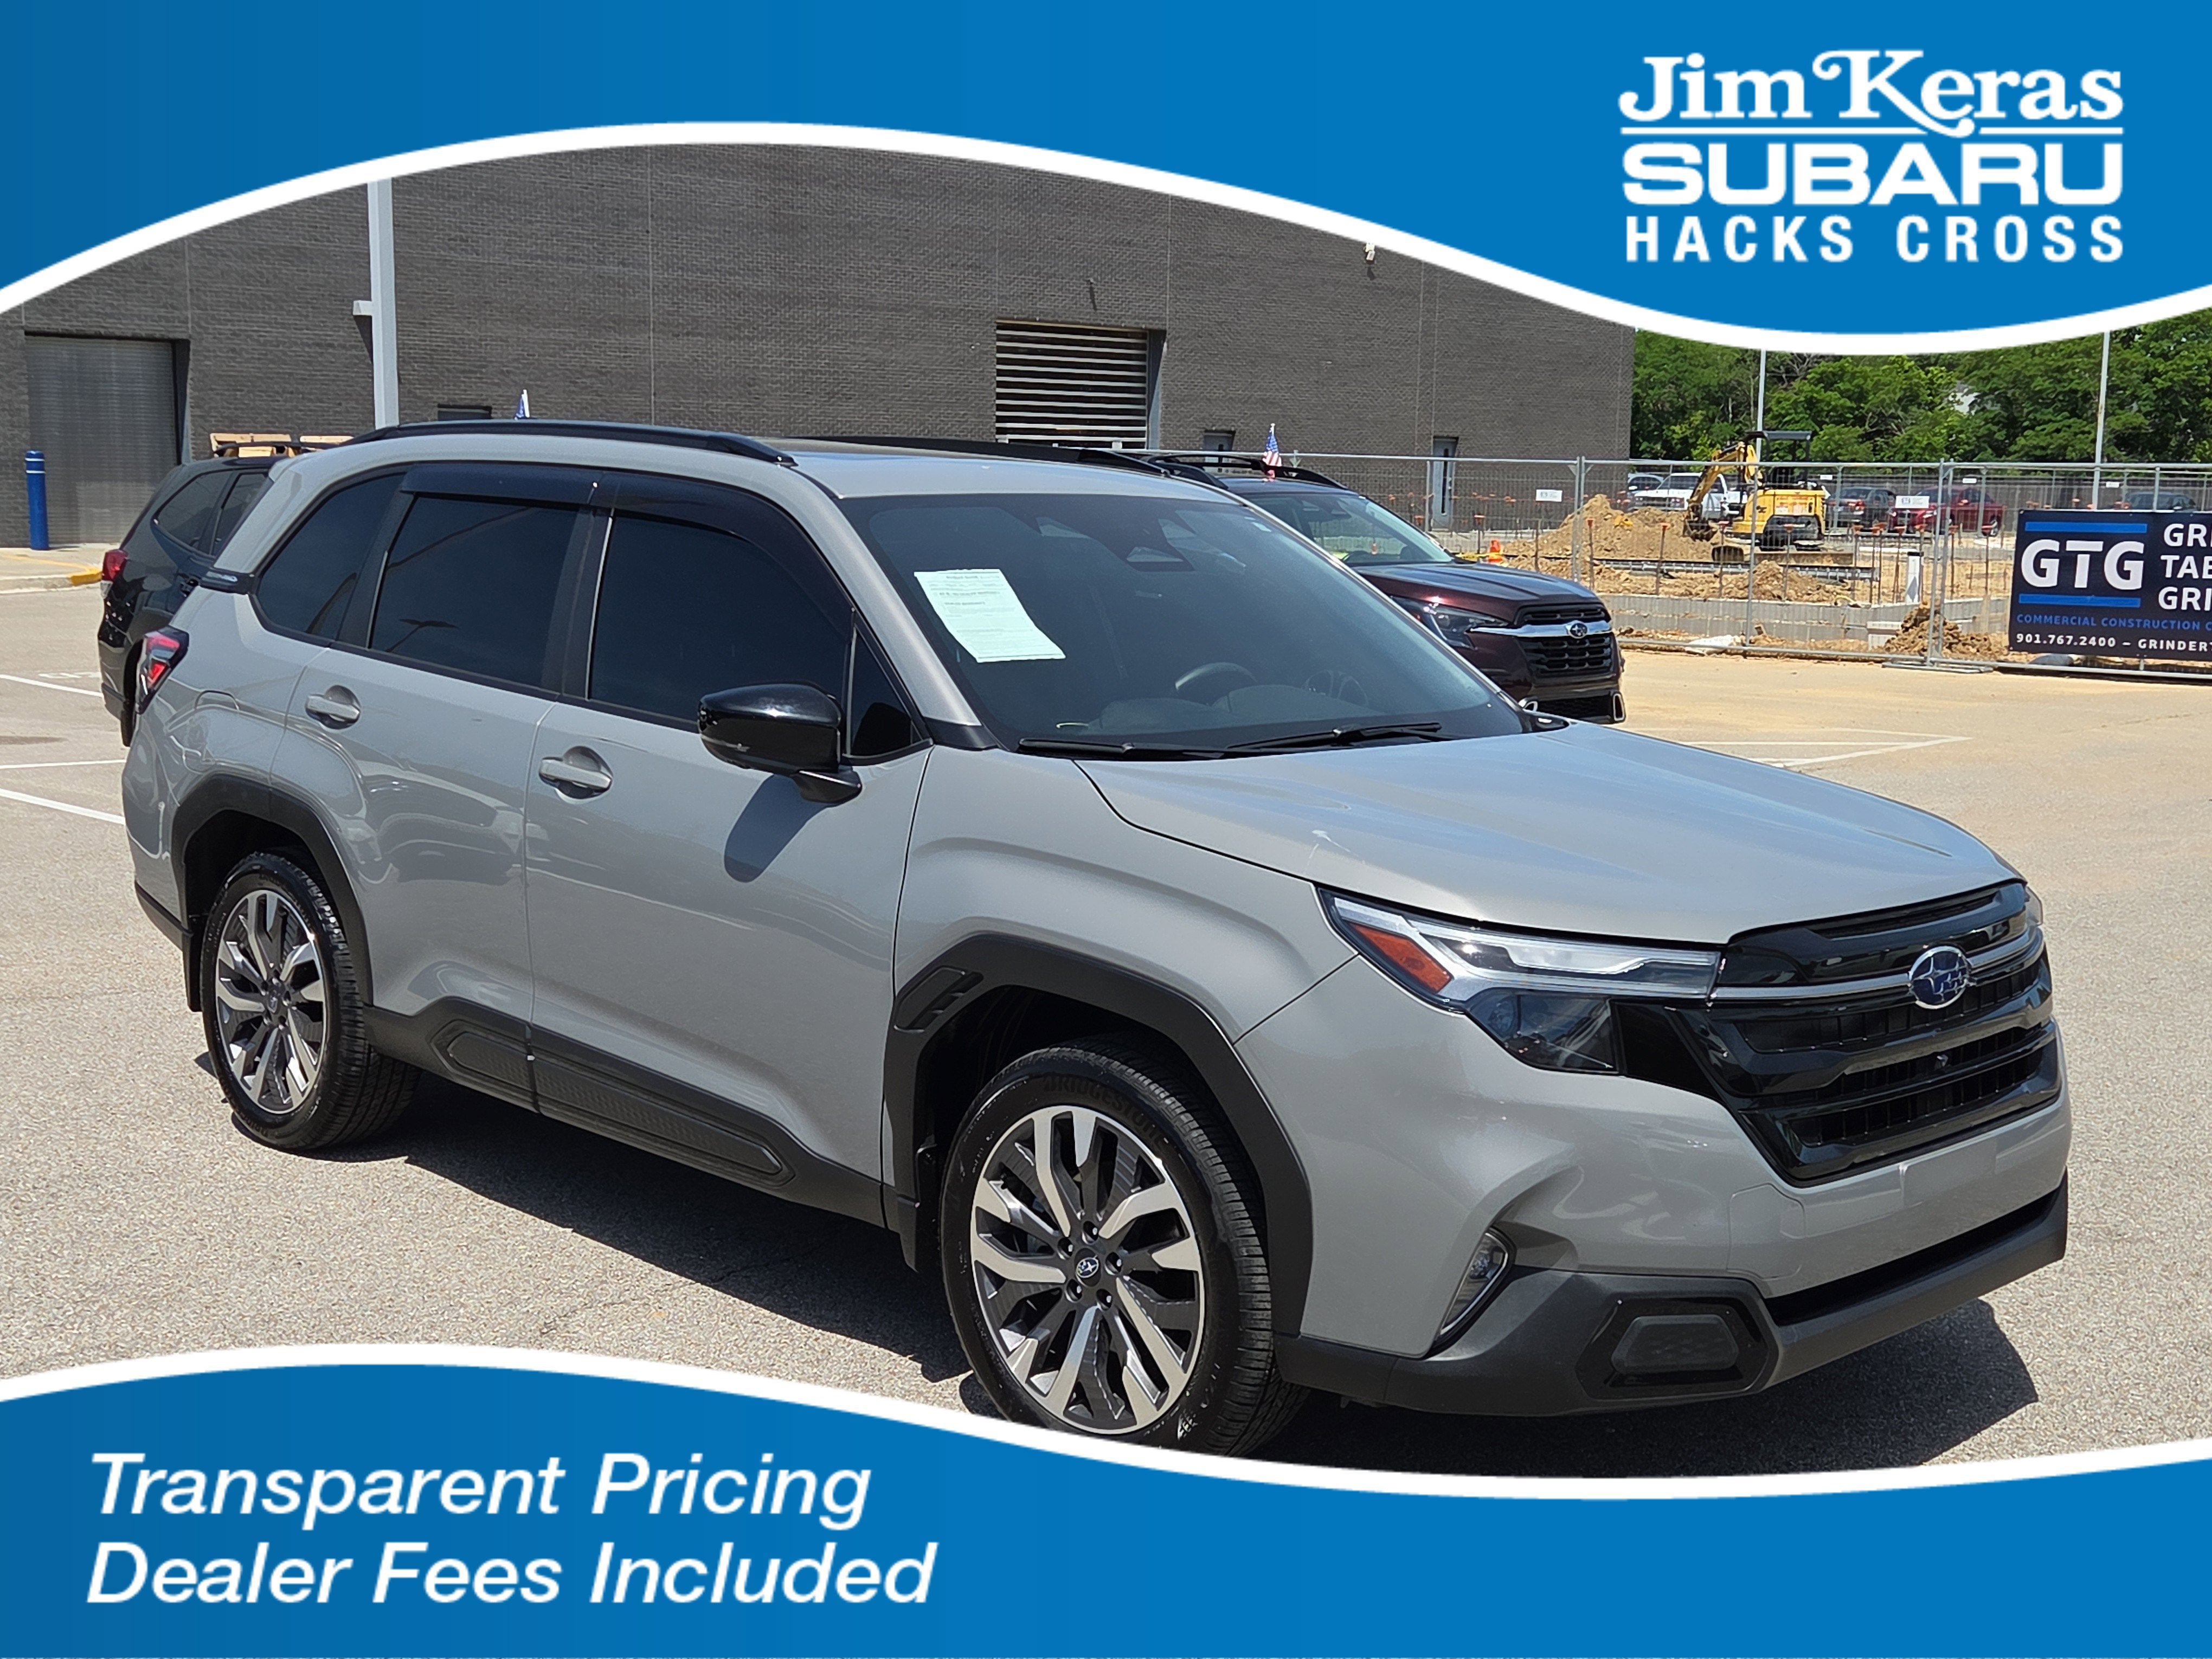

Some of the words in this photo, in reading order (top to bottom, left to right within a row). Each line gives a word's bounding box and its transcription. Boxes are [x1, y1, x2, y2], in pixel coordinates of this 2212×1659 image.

[2164, 523, 2212, 547] GR
[2021, 539, 2145, 590] GTG
[2016, 614, 2097, 626] COMMERCIAL
[2101, 617, 2200, 631] CONSTRUCTION
[2016, 633, 2116, 647] 901.767.2400
